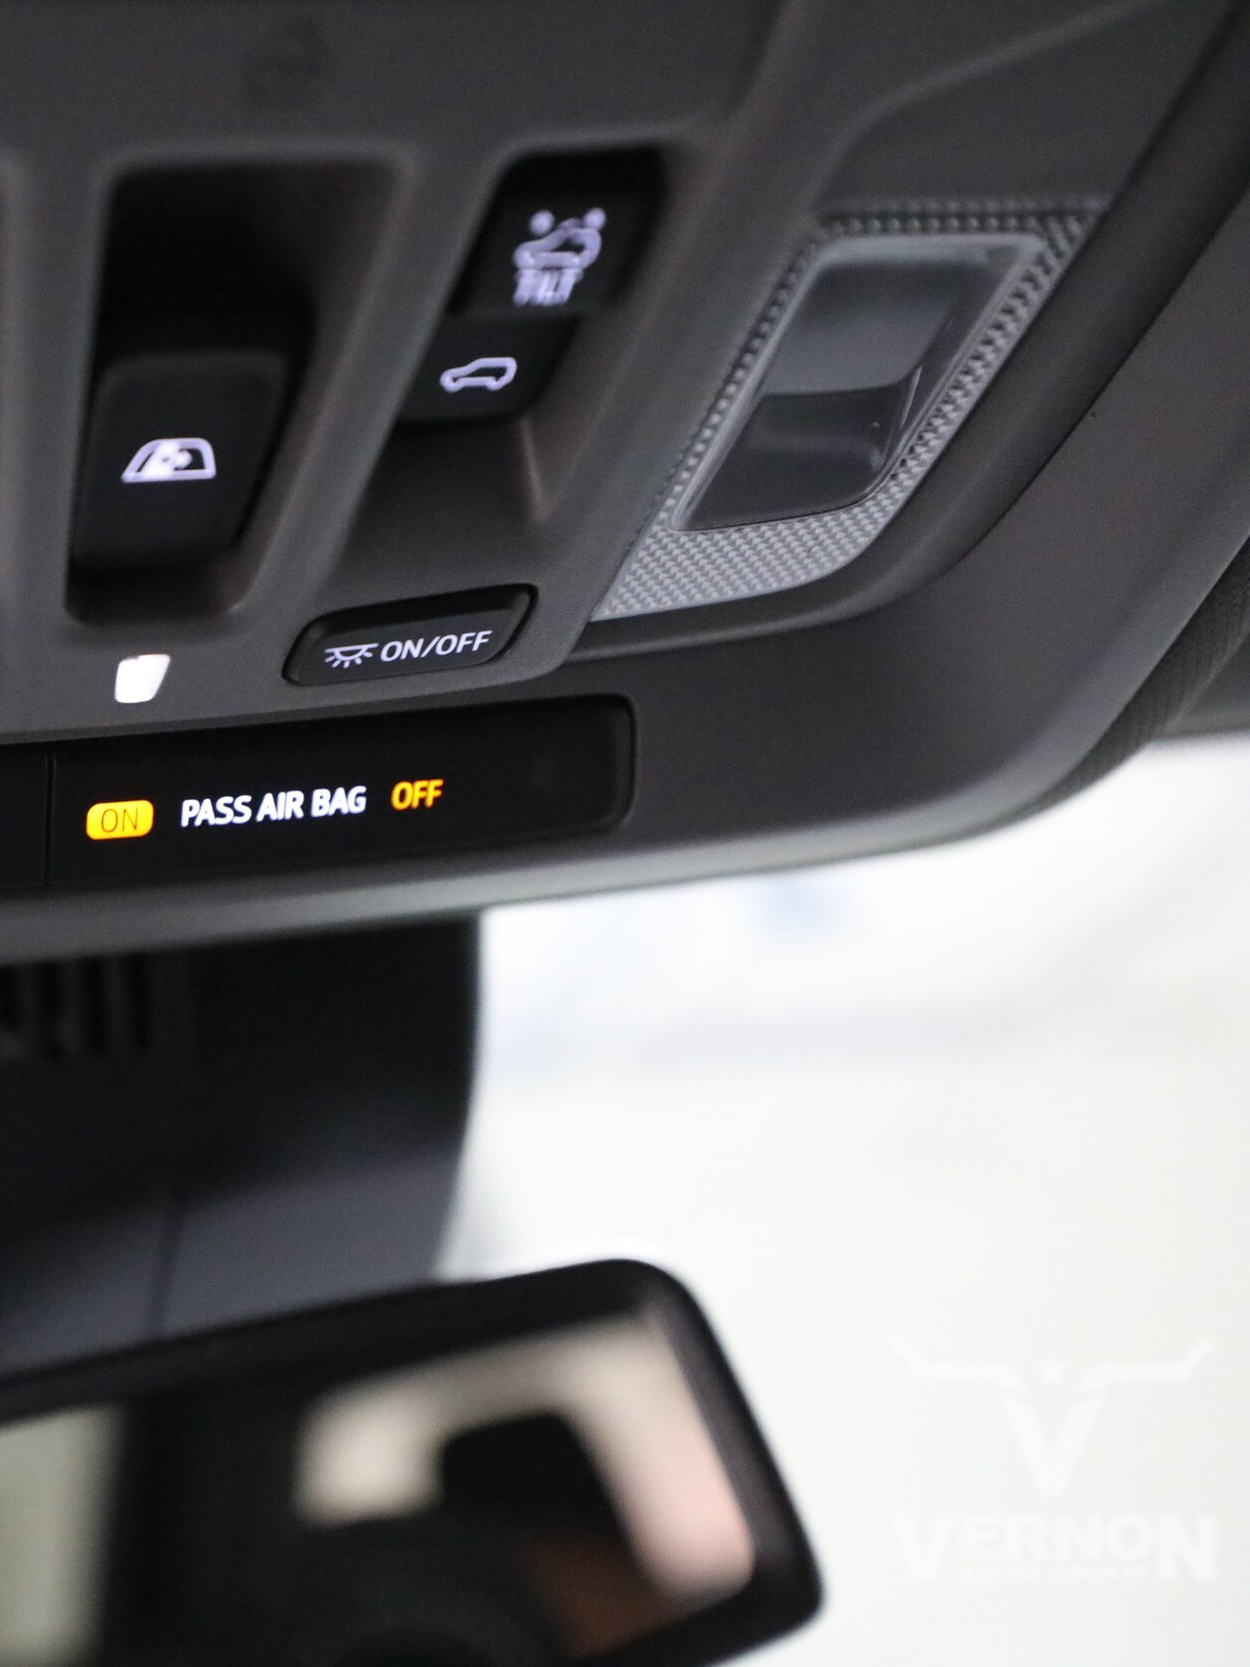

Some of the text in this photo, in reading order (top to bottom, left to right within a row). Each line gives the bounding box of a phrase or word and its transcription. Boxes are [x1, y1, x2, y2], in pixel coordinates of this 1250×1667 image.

[379, 630, 493, 663] ON/OFF
[101, 778, 444, 833] ON PASS AIR BAG OFF
